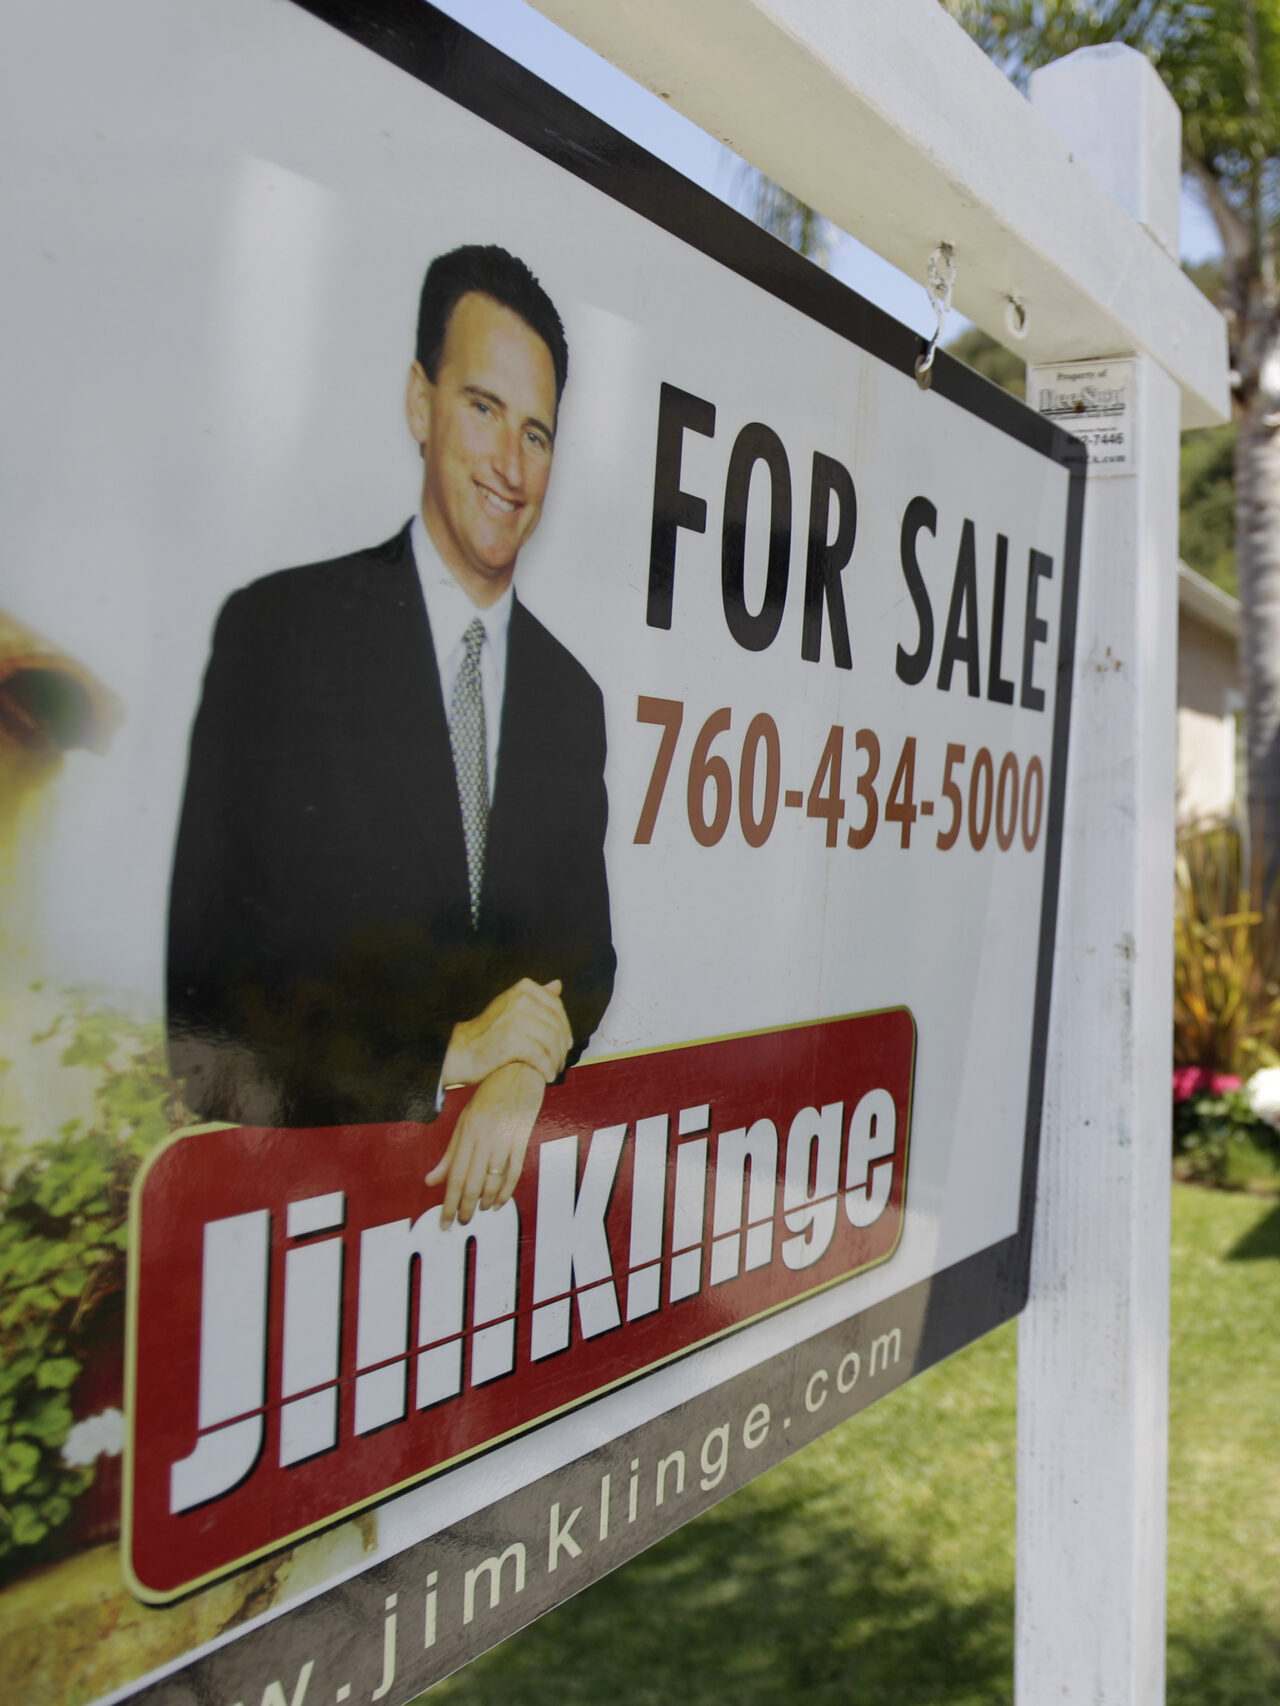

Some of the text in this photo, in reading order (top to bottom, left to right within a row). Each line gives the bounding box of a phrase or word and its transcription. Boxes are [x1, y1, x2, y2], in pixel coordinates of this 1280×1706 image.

[646, 381, 1054, 712] FOR SALE
[633, 695, 1044, 853] 760-434-5000
